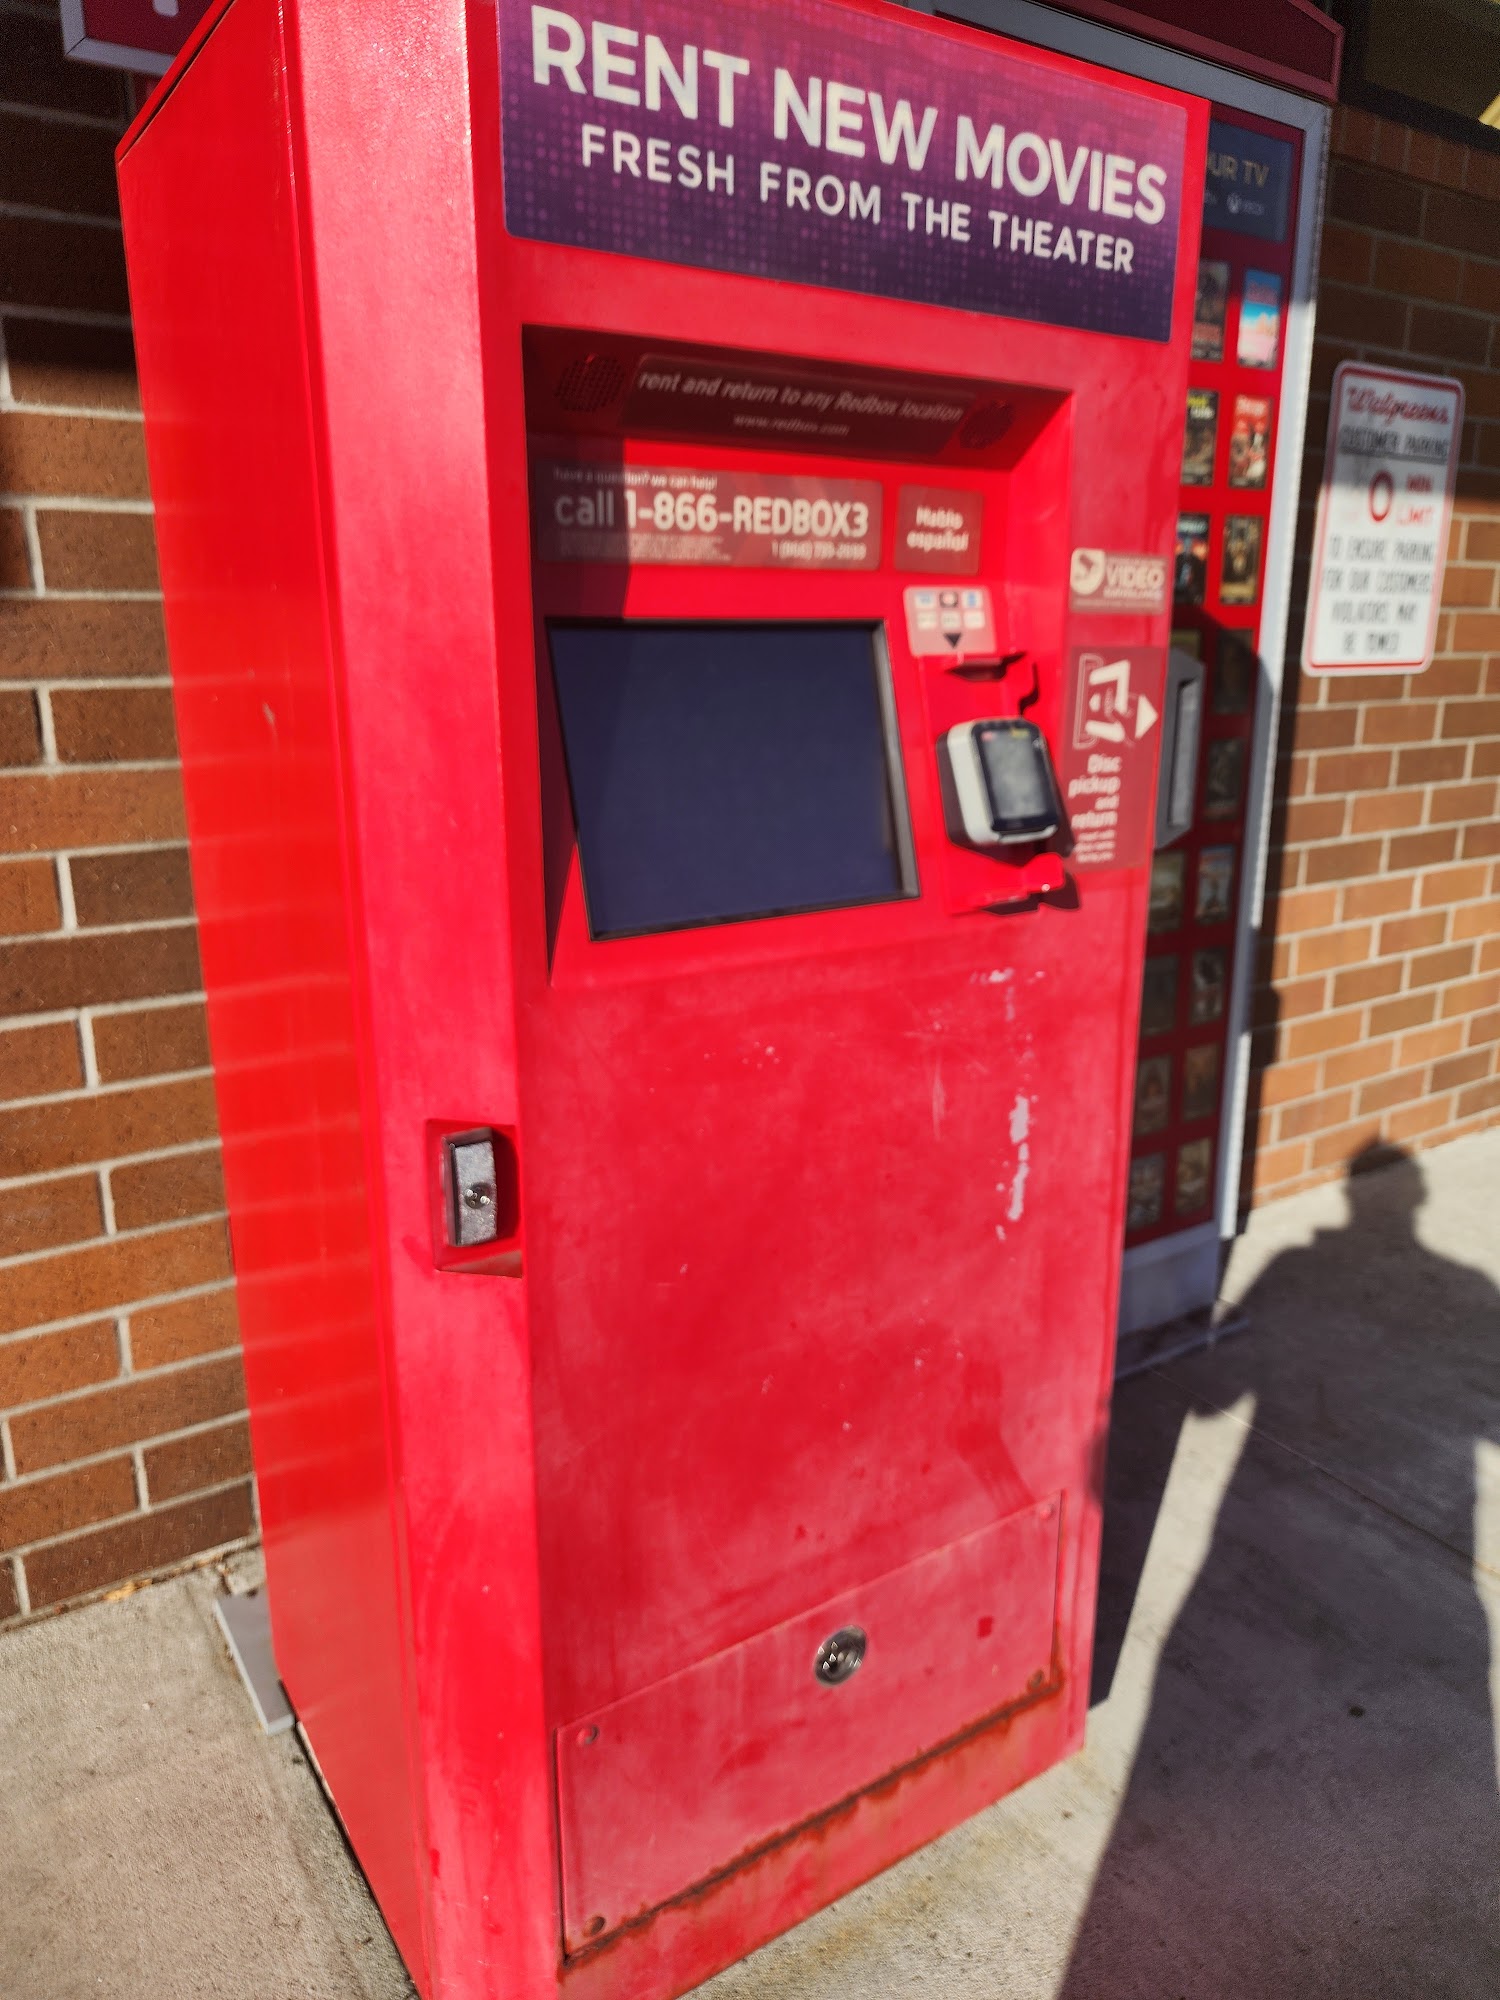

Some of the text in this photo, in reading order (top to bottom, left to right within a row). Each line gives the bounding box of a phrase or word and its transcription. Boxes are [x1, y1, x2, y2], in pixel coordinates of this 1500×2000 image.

[532, 4, 1168, 225] RENT NEW MOVIES
[581, 123, 1135, 275] FRESH FROM THE THEATER
[1242, 160, 1269, 188] TV
[638, 371, 964, 422] rent and return to any Redbox location
[555, 488, 869, 538] call 1-866-REDBOX3
[1105, 563, 1166, 591] VIDEO
